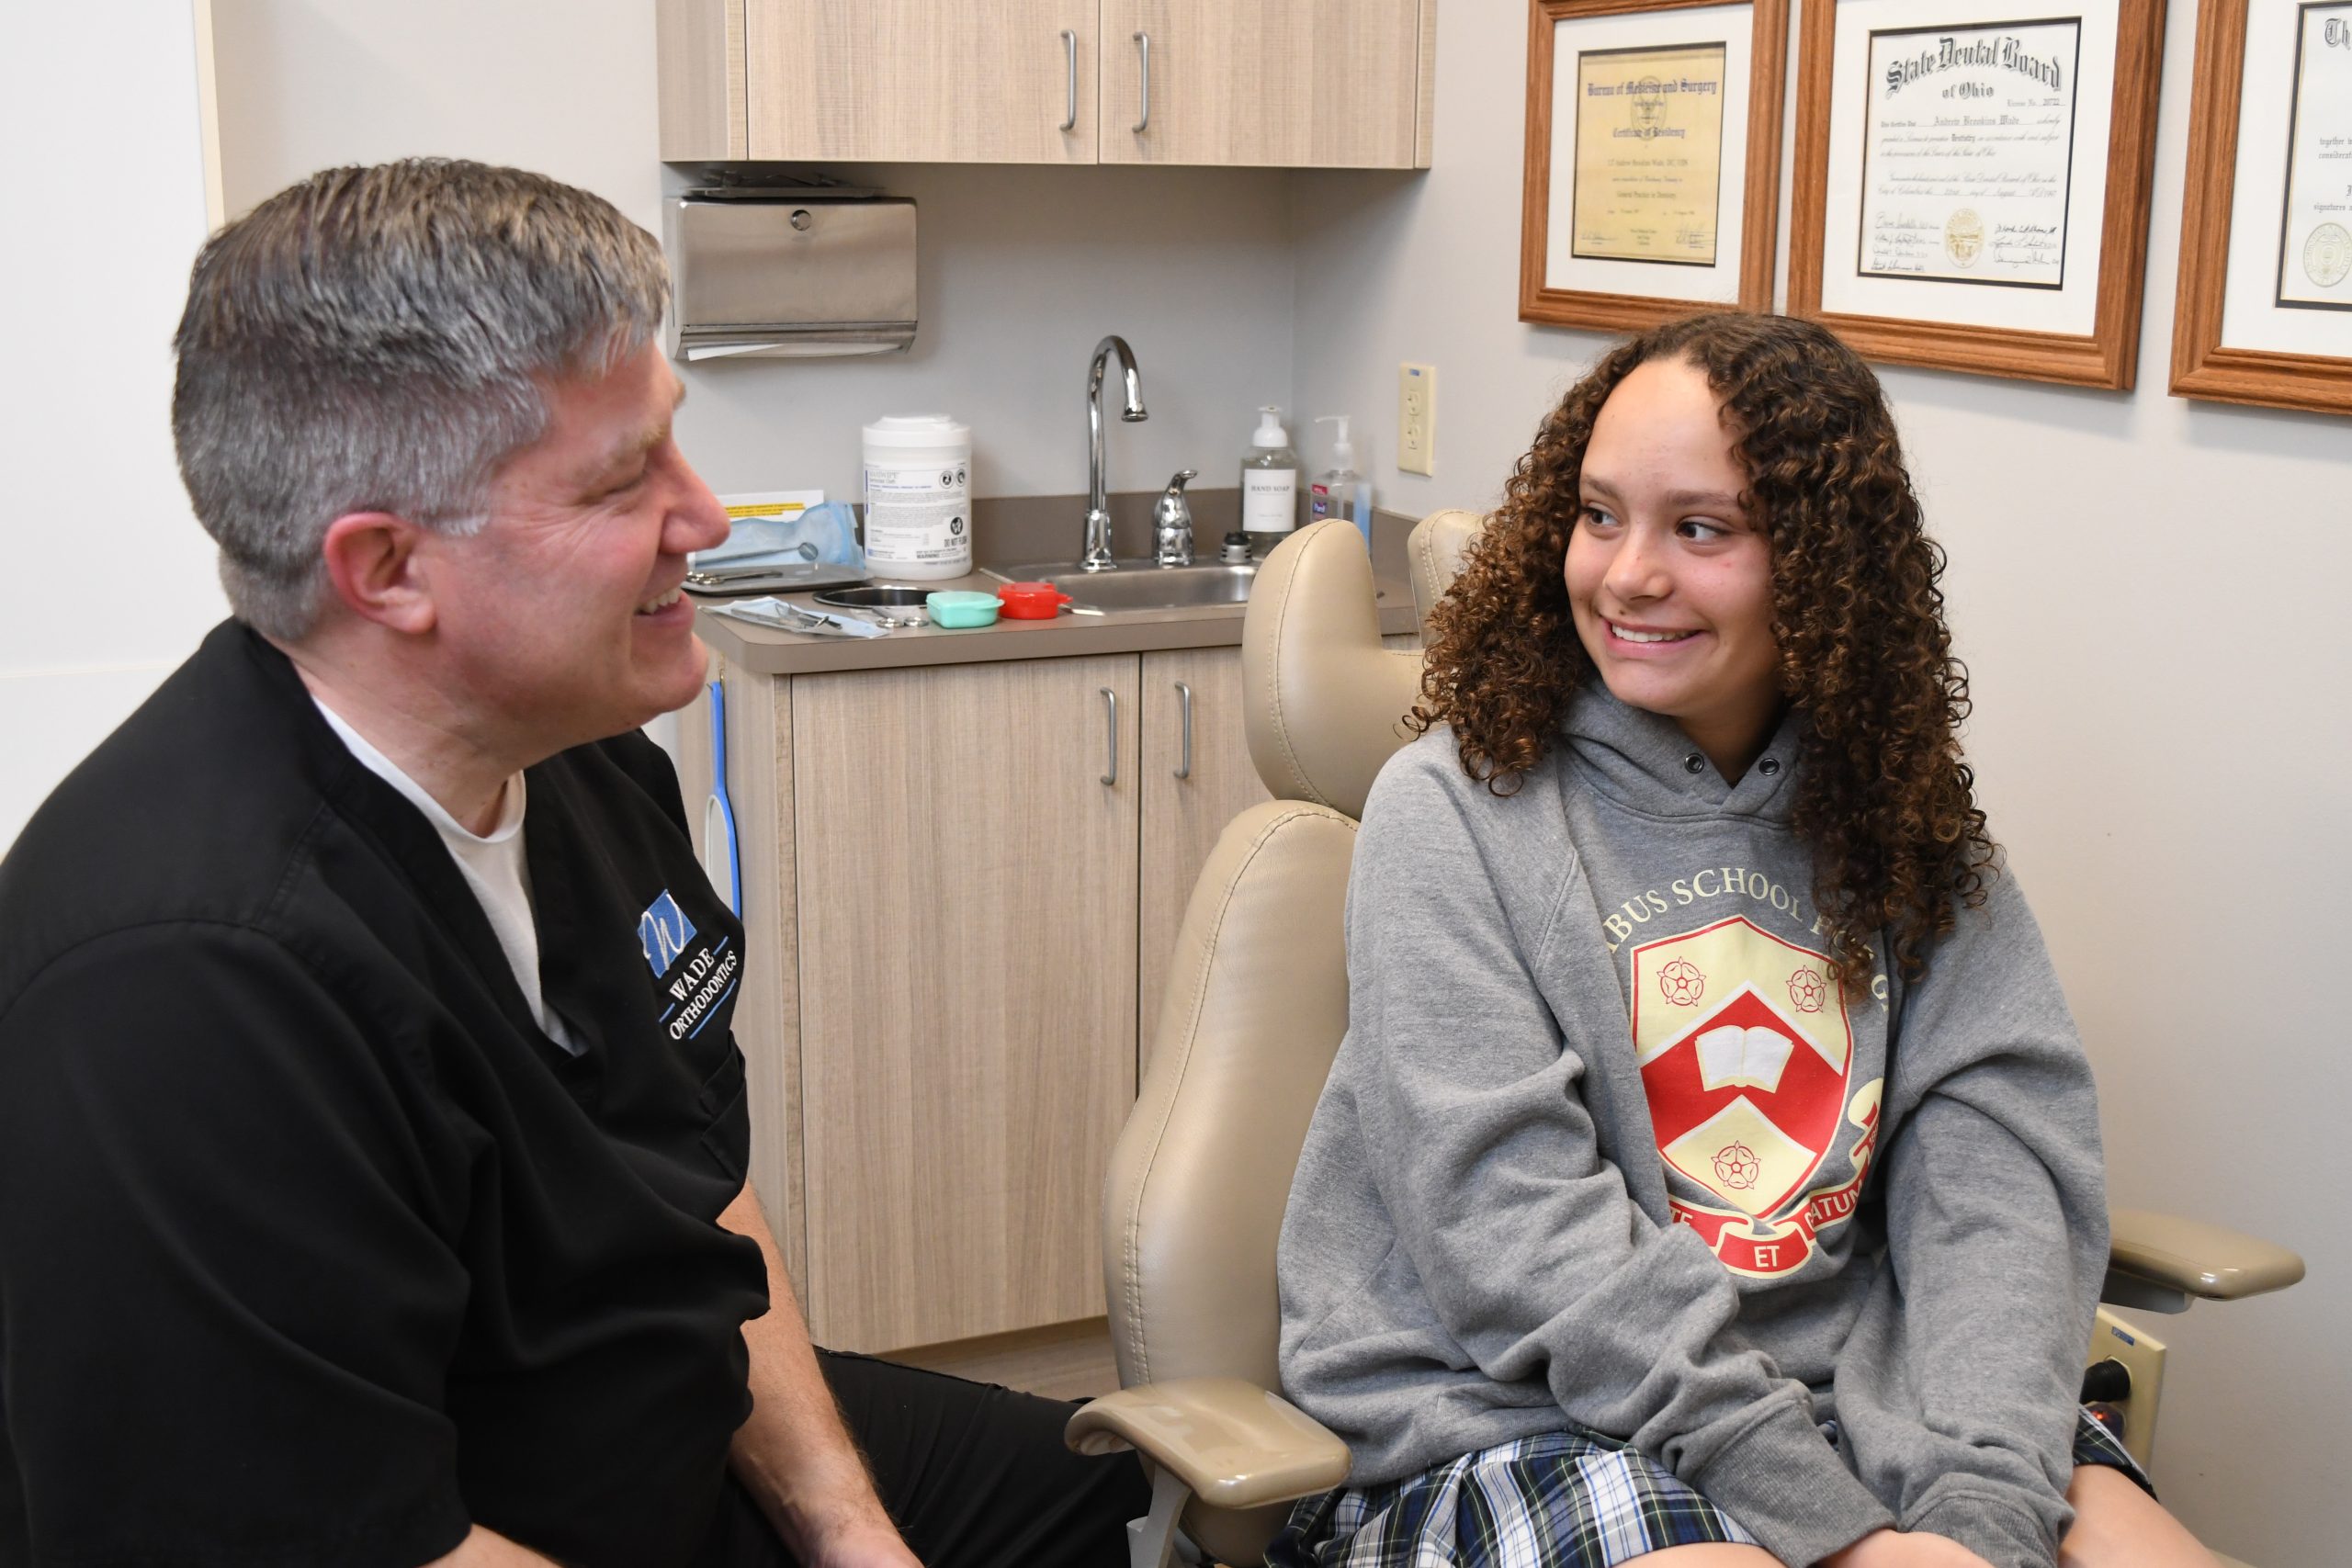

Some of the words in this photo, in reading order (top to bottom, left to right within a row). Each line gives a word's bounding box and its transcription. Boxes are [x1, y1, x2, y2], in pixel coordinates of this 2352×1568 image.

[2324, 17, 2352, 50] Th
[1617, 82, 1624, 95] of
[1626, 81, 1660, 95] Medicine
[1662, 79, 1678, 93] and
[1680, 78, 1717, 95] Surgery
[1885, 51, 1936, 99] State
[1939, 36, 1999, 71] Dental
[2001, 36, 2062, 93] Board
[1941, 83, 1955, 99] of
[1959, 81, 1995, 100] Ohio
[1602, 889, 1668, 953] BUS
[1671, 867, 1804, 923] SCHOOL
[669, 947, 716, 1001] WADE
[669, 950, 737, 1040] ORTHODONTICS
[1753, 1245, 1781, 1268] ET
